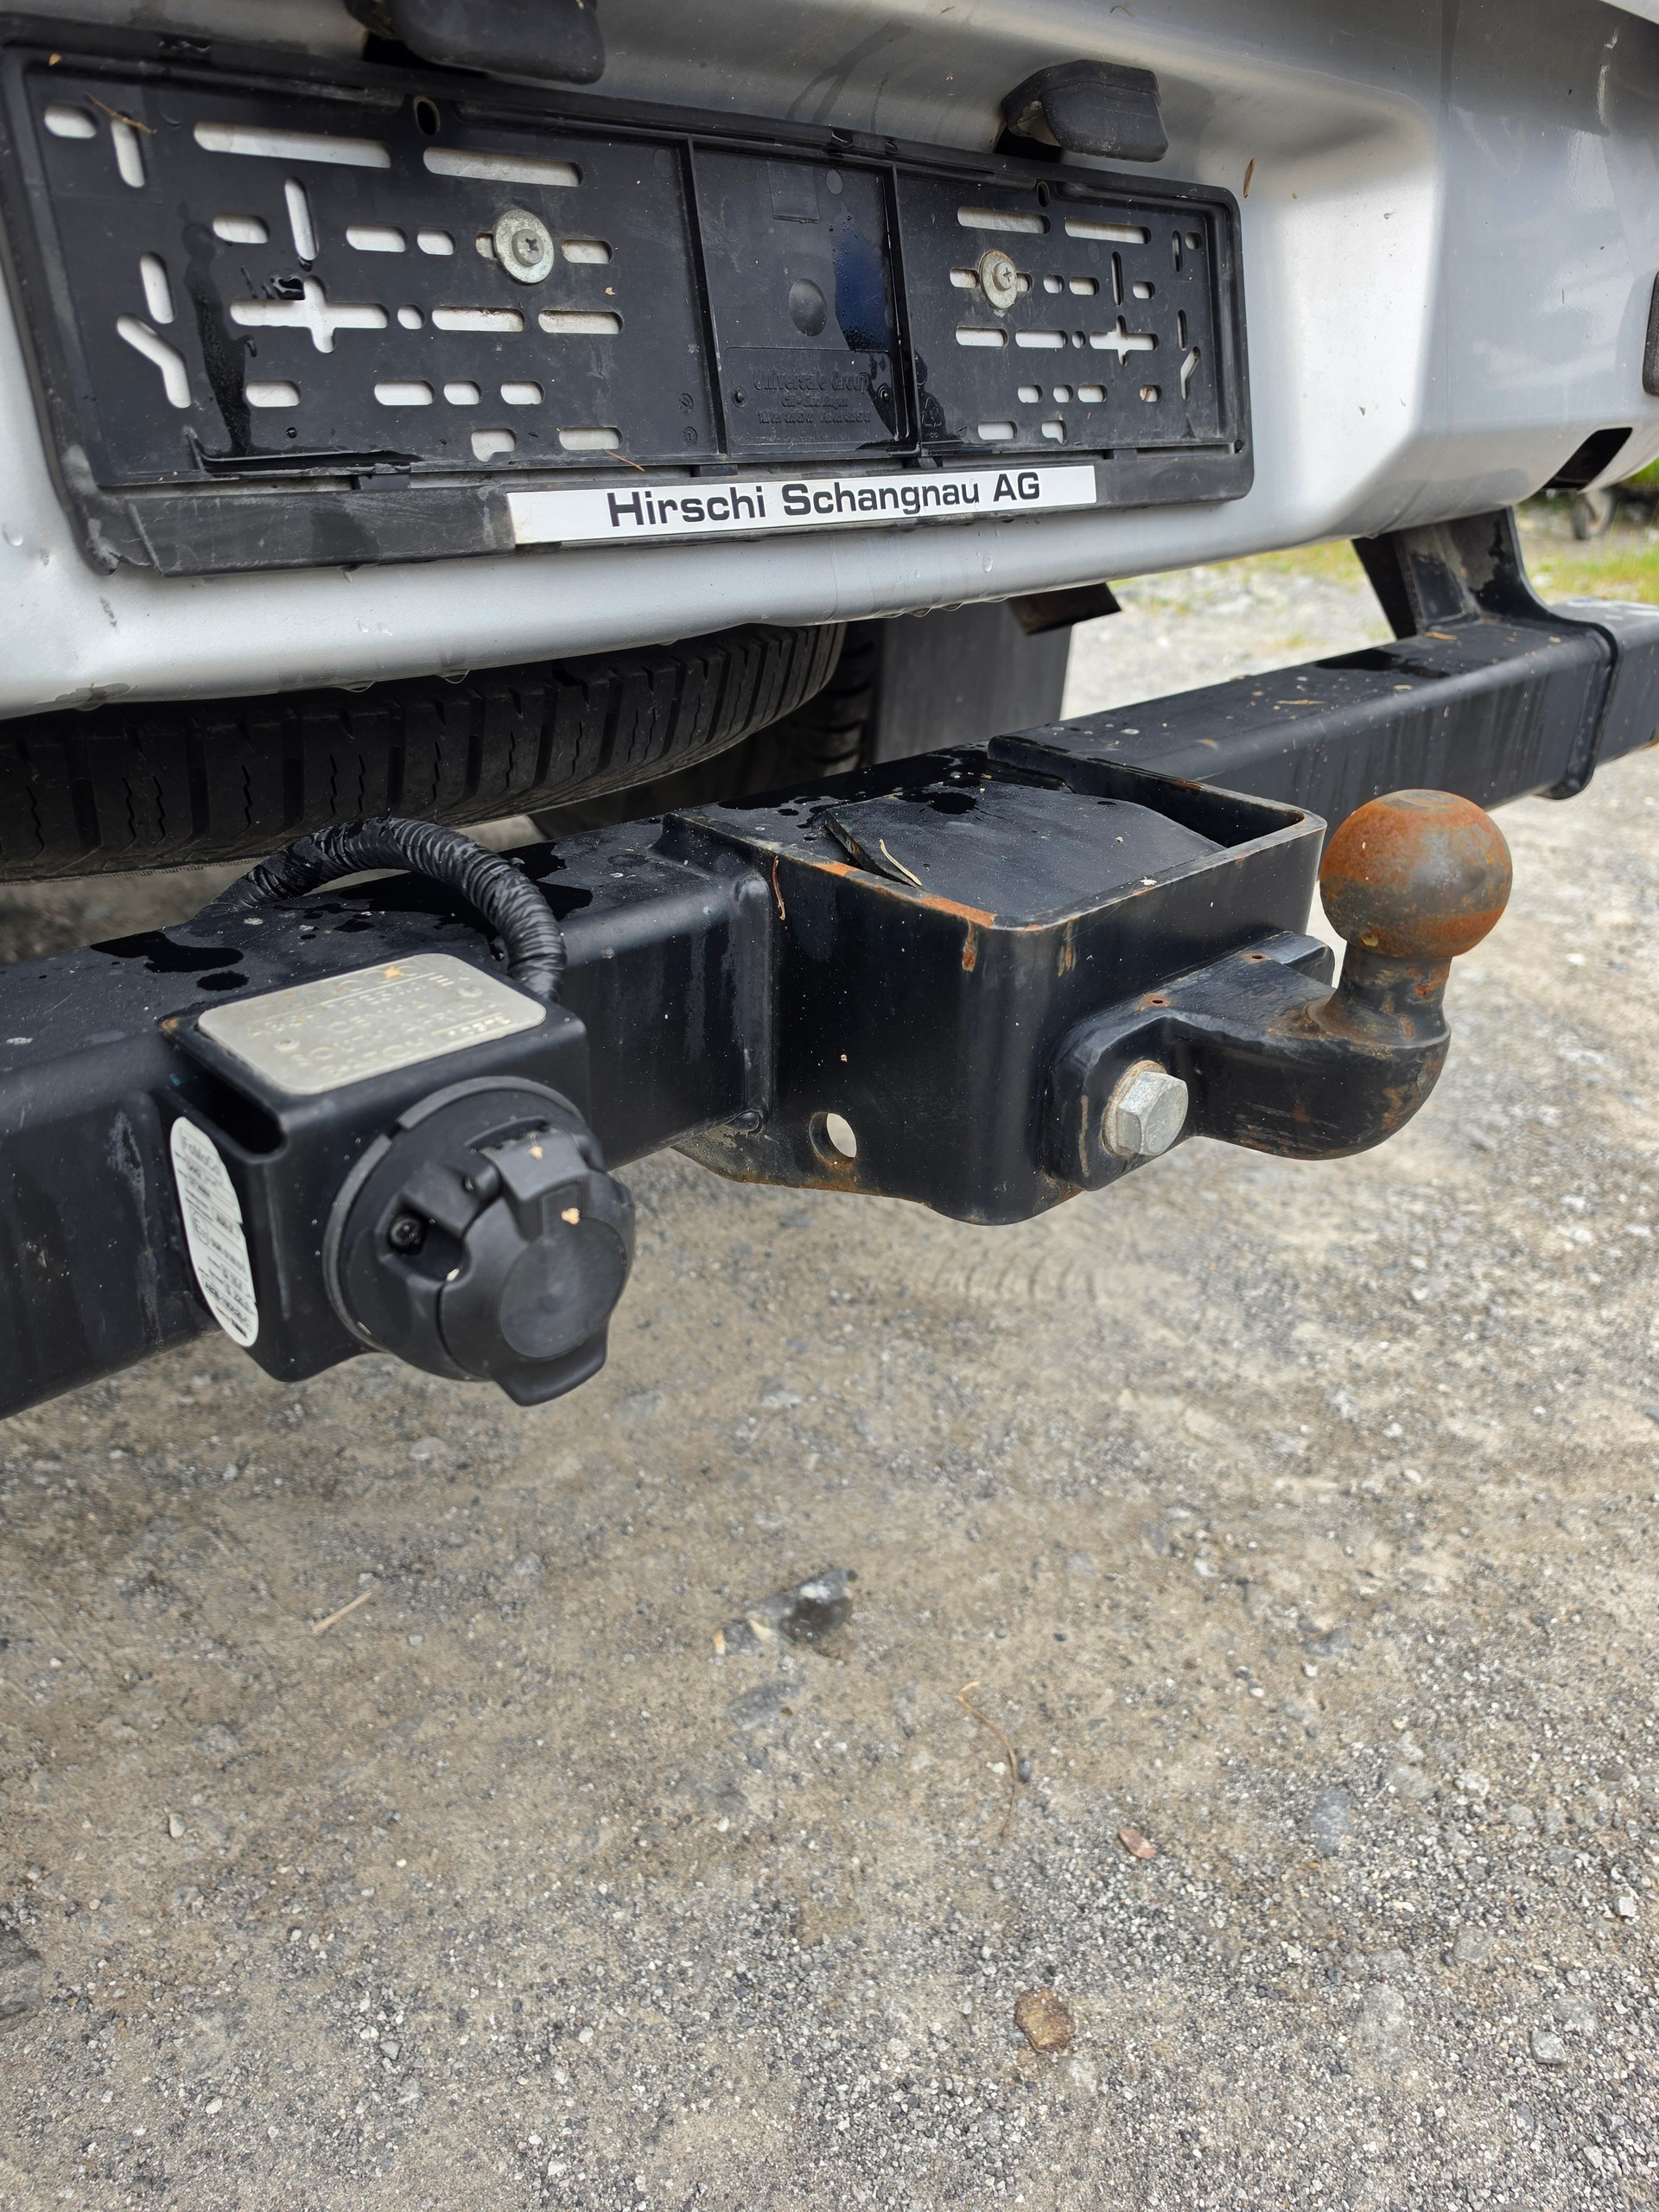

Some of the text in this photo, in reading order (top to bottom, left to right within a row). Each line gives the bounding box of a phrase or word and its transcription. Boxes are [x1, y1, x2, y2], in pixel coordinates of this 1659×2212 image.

[831, 371, 869, 393] Group
[607, 472, 1039, 527] Hirschi Schangnau AG
